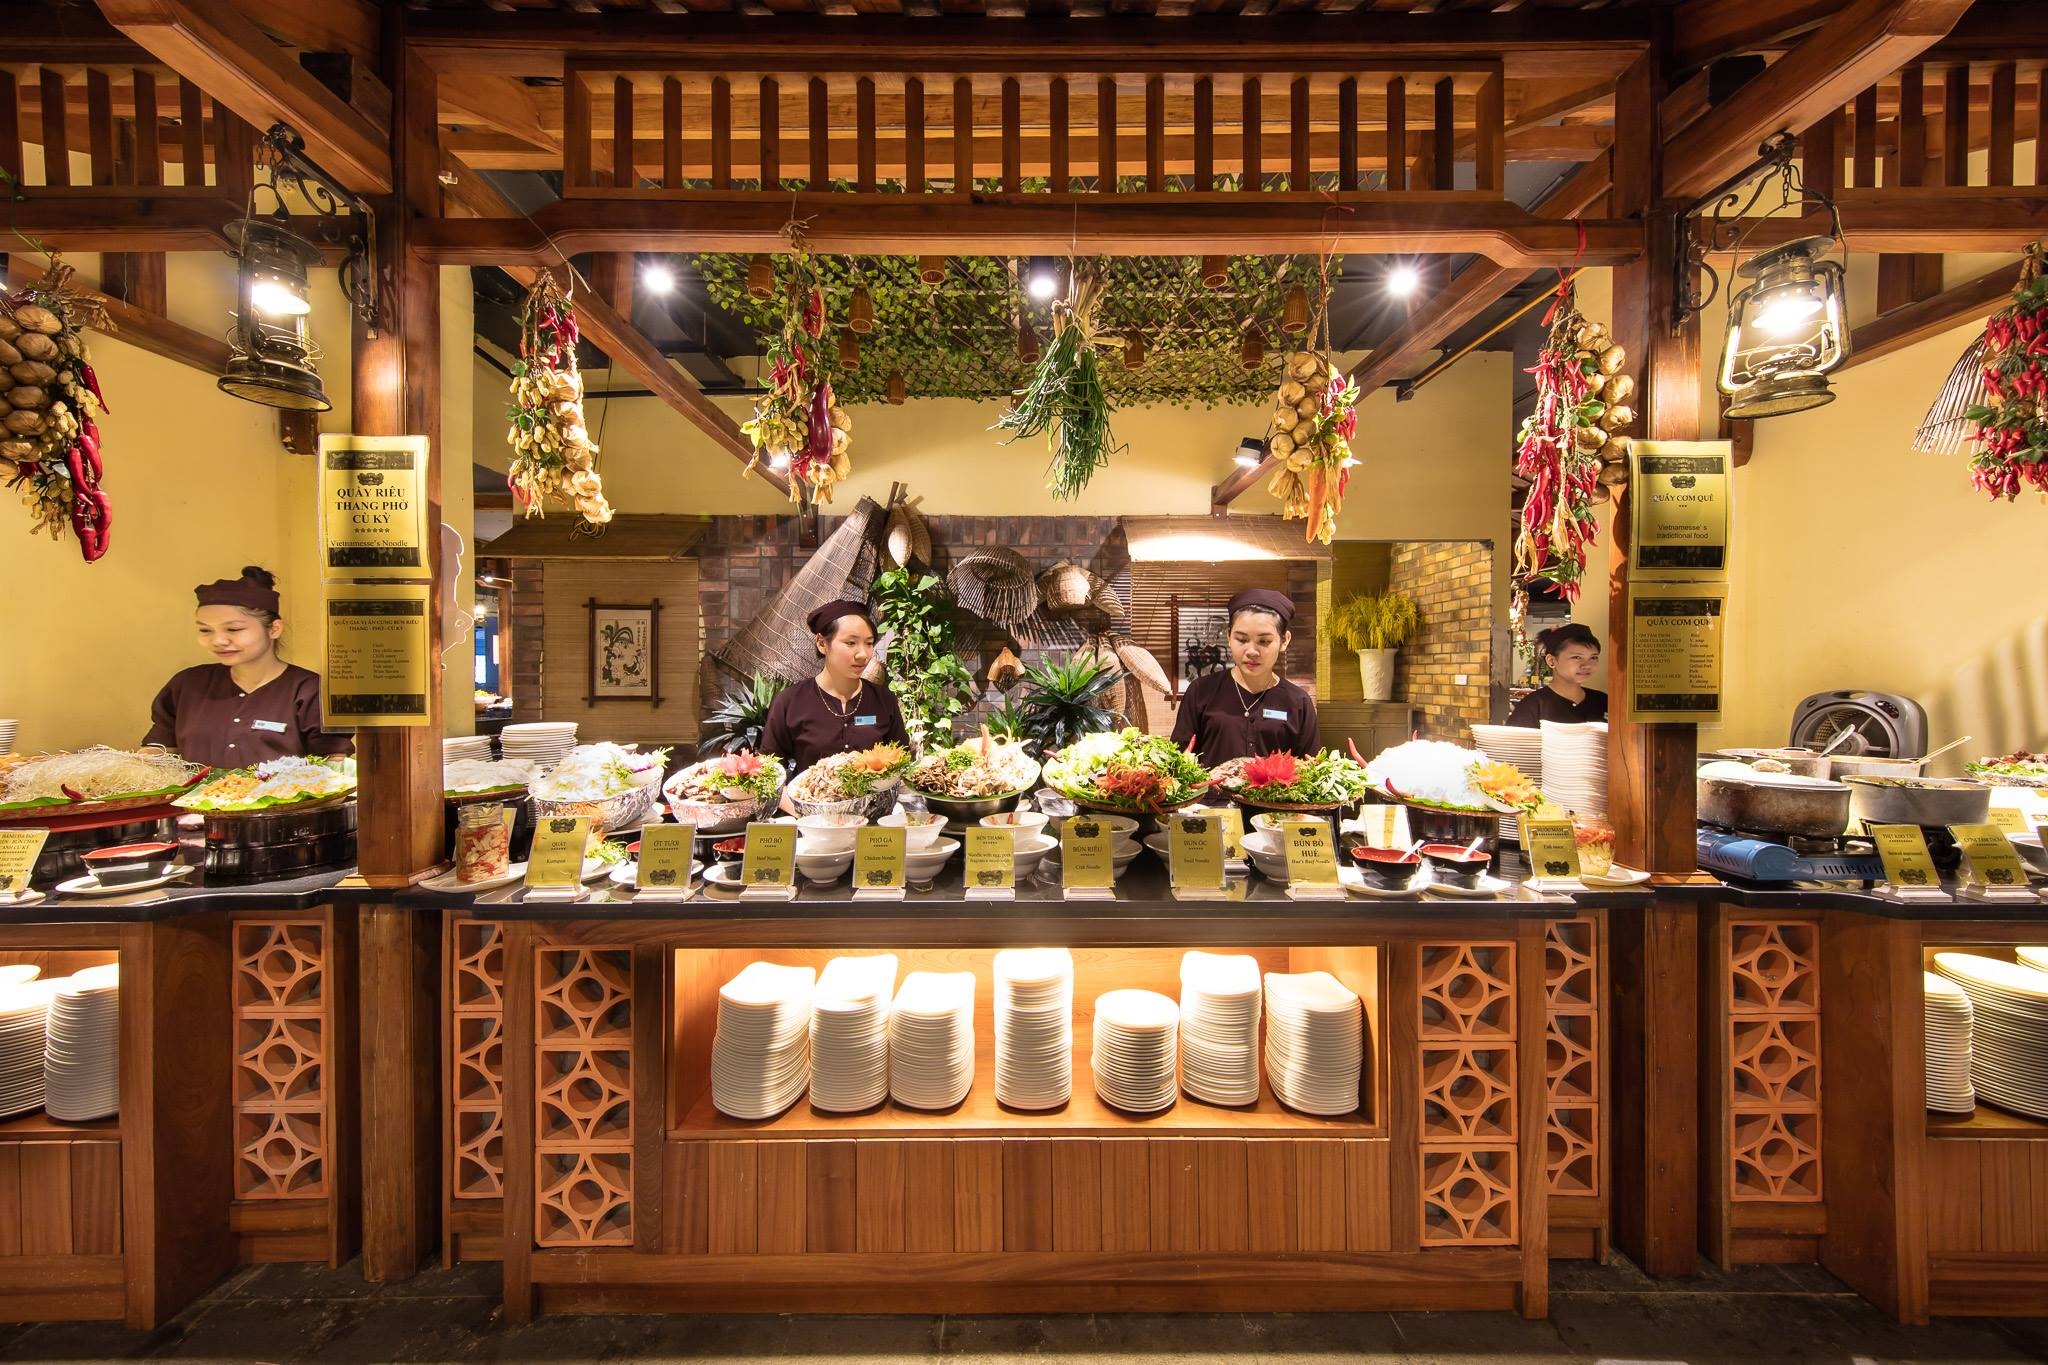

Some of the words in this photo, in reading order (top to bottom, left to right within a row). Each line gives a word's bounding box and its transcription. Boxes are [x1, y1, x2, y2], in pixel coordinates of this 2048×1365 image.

[376, 485, 405, 497] RIÊU
[335, 501, 378, 510] THANG
[353, 512, 369, 523] CÙ
[373, 512, 391, 523] KỲ
[1293, 838, 1311, 847] BÚN
